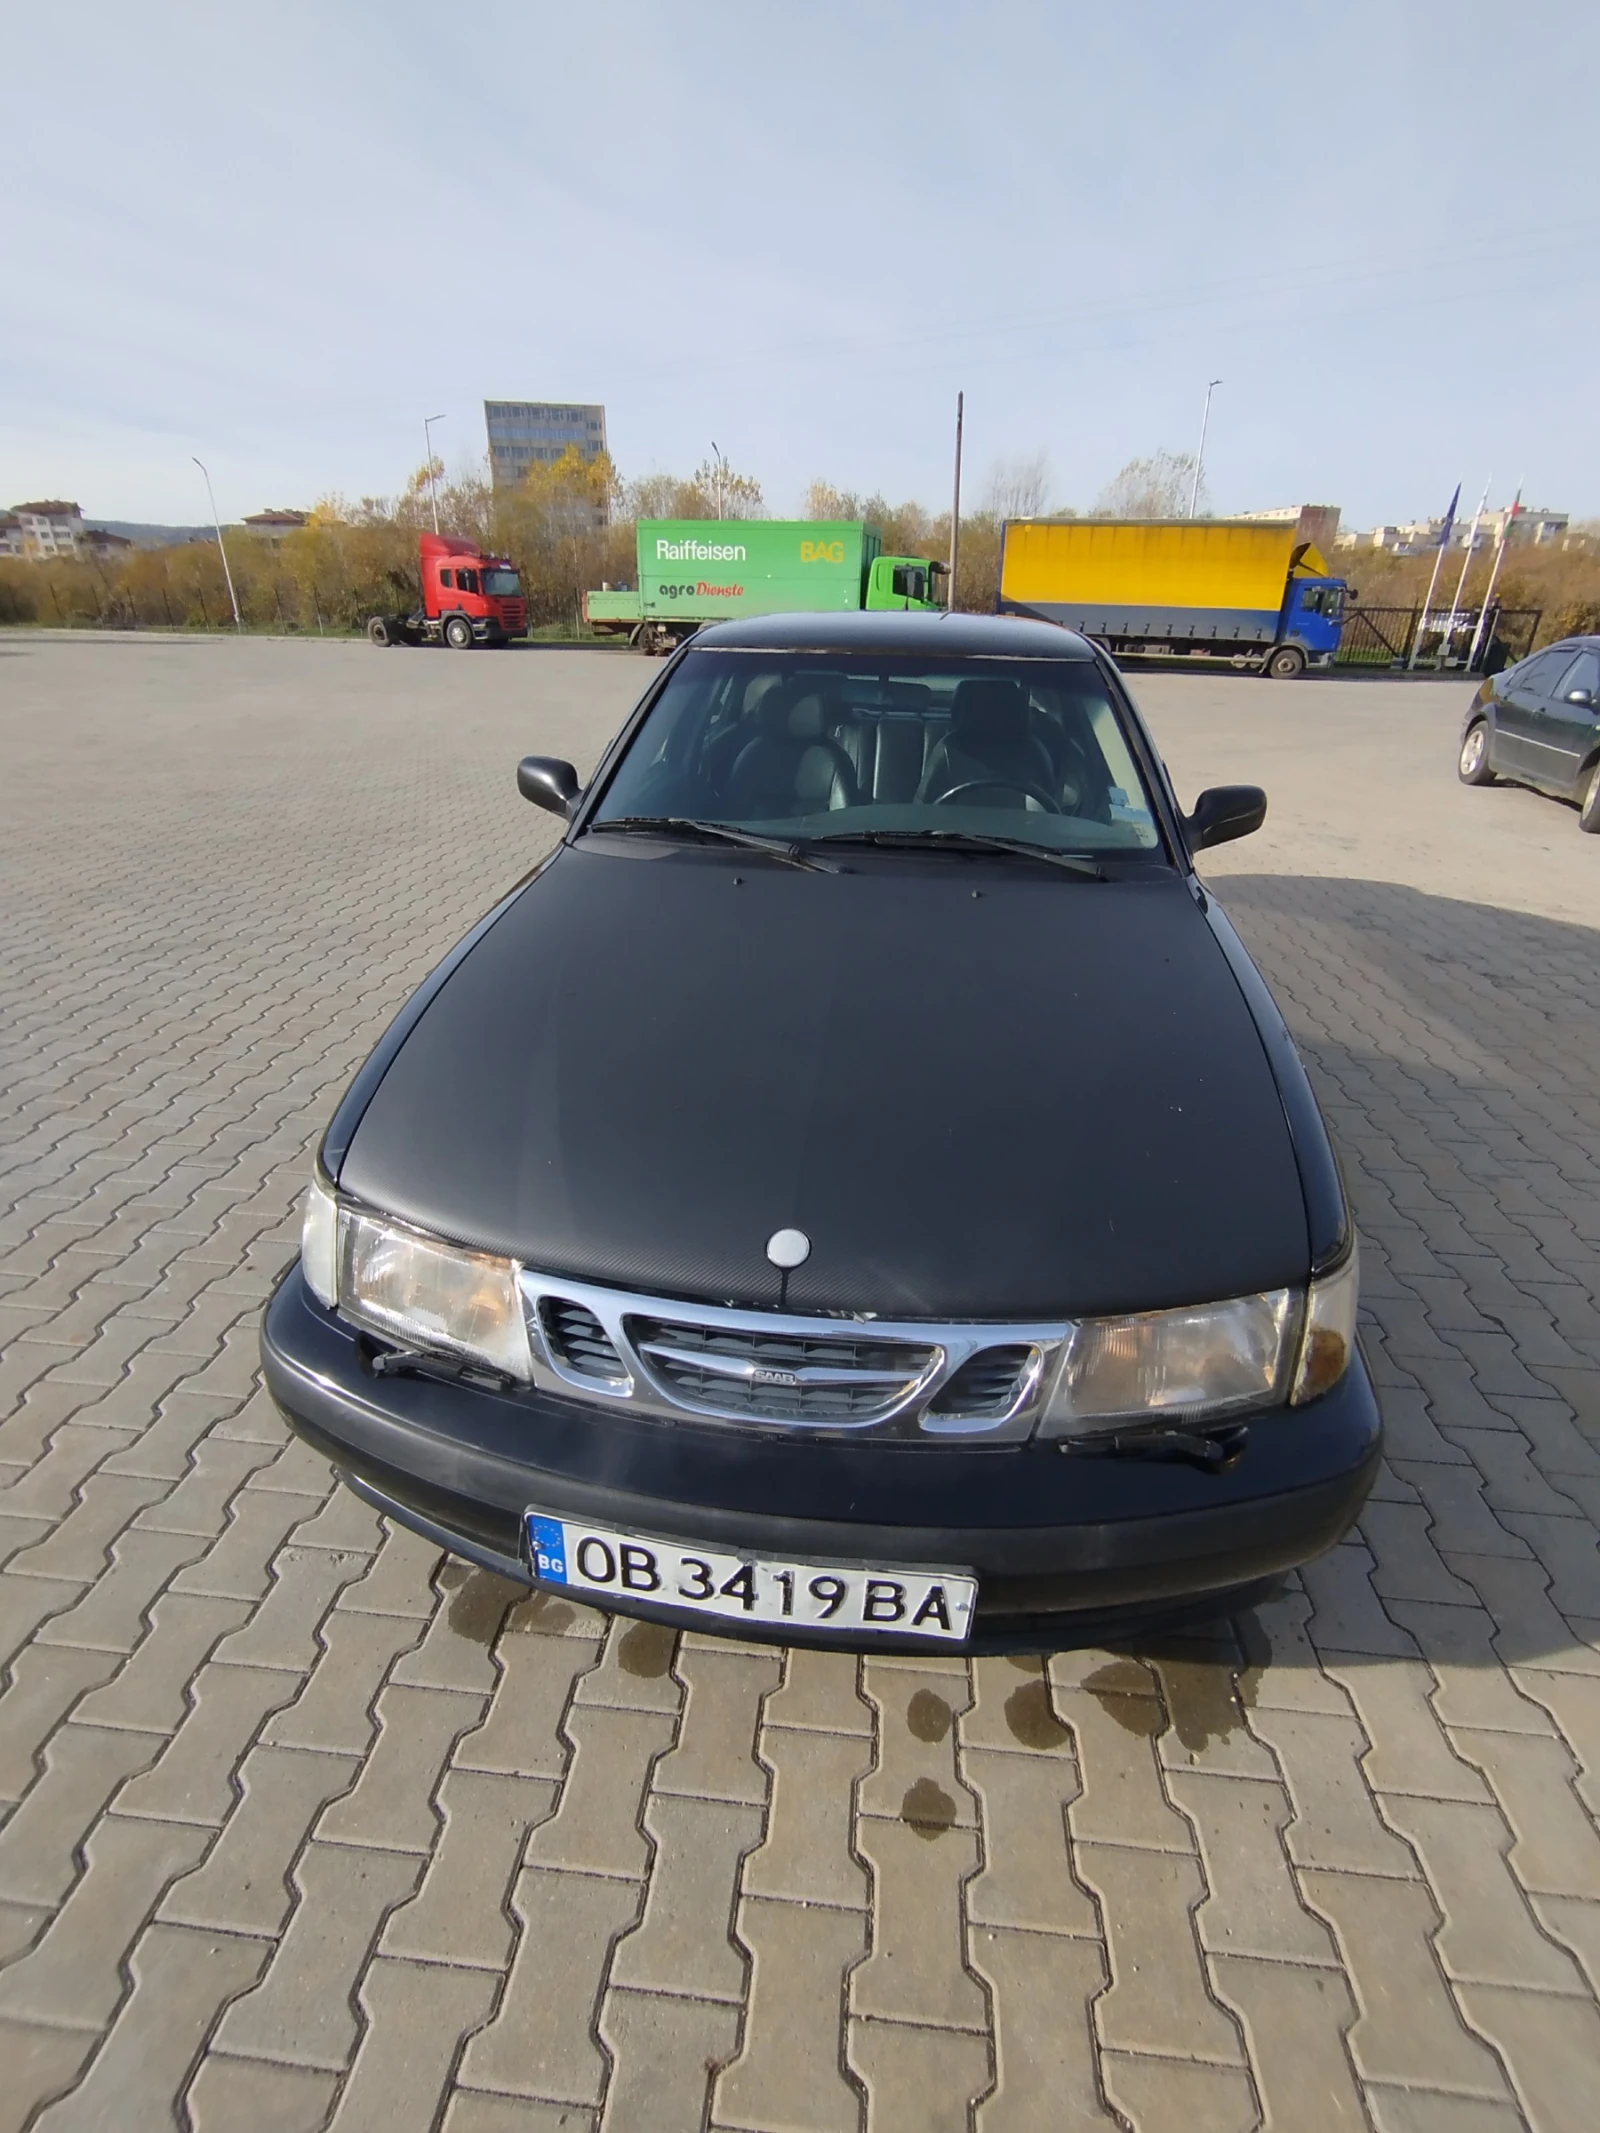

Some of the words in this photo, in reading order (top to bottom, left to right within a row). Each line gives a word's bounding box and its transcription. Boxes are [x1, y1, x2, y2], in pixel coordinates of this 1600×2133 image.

[656, 539, 747, 562] Raiffeisen
[801, 541, 844, 562] BAG
[754, 1370, 794, 1383] SAAB
[538, 1553, 564, 1574] BG
